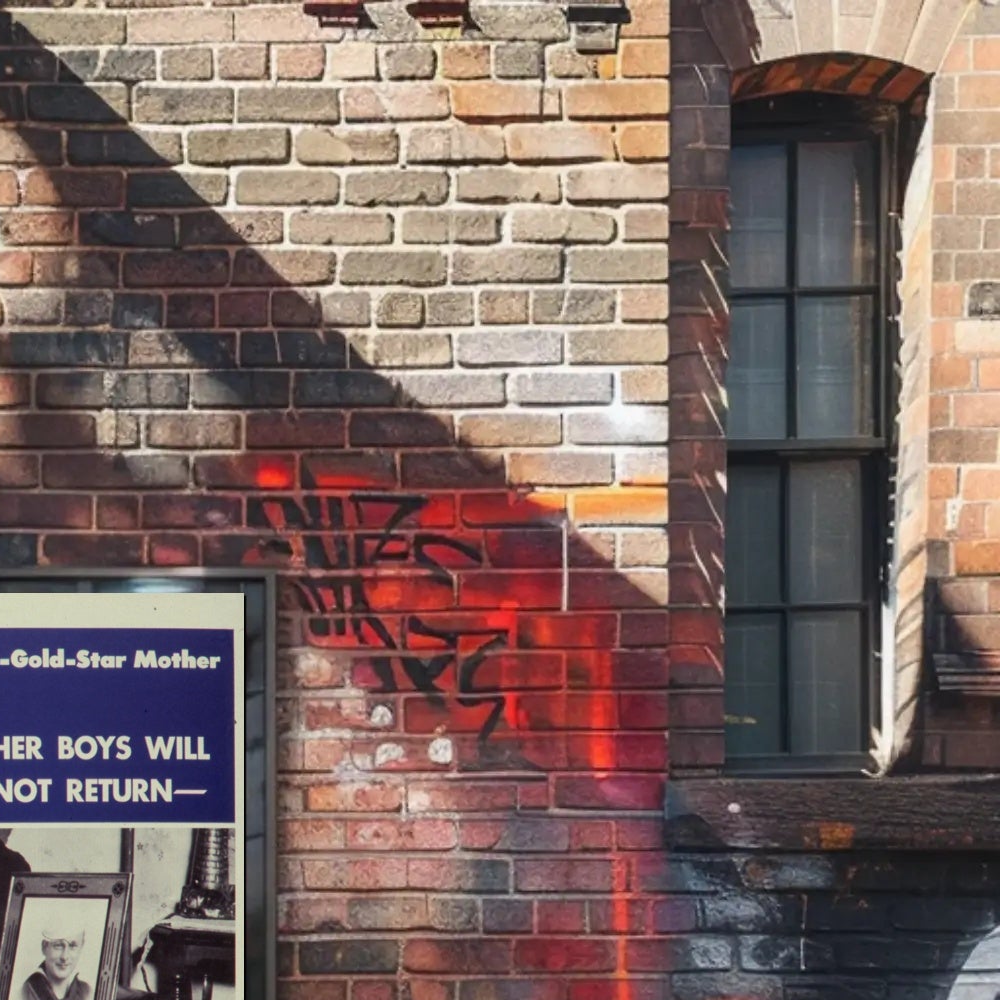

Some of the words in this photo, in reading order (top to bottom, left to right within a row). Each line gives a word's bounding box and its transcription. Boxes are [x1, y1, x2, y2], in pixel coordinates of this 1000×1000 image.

[134, 649, 221, 669] Mother
[57, 736, 132, 760] BOYS
[145, 736, 211, 760] WILL
